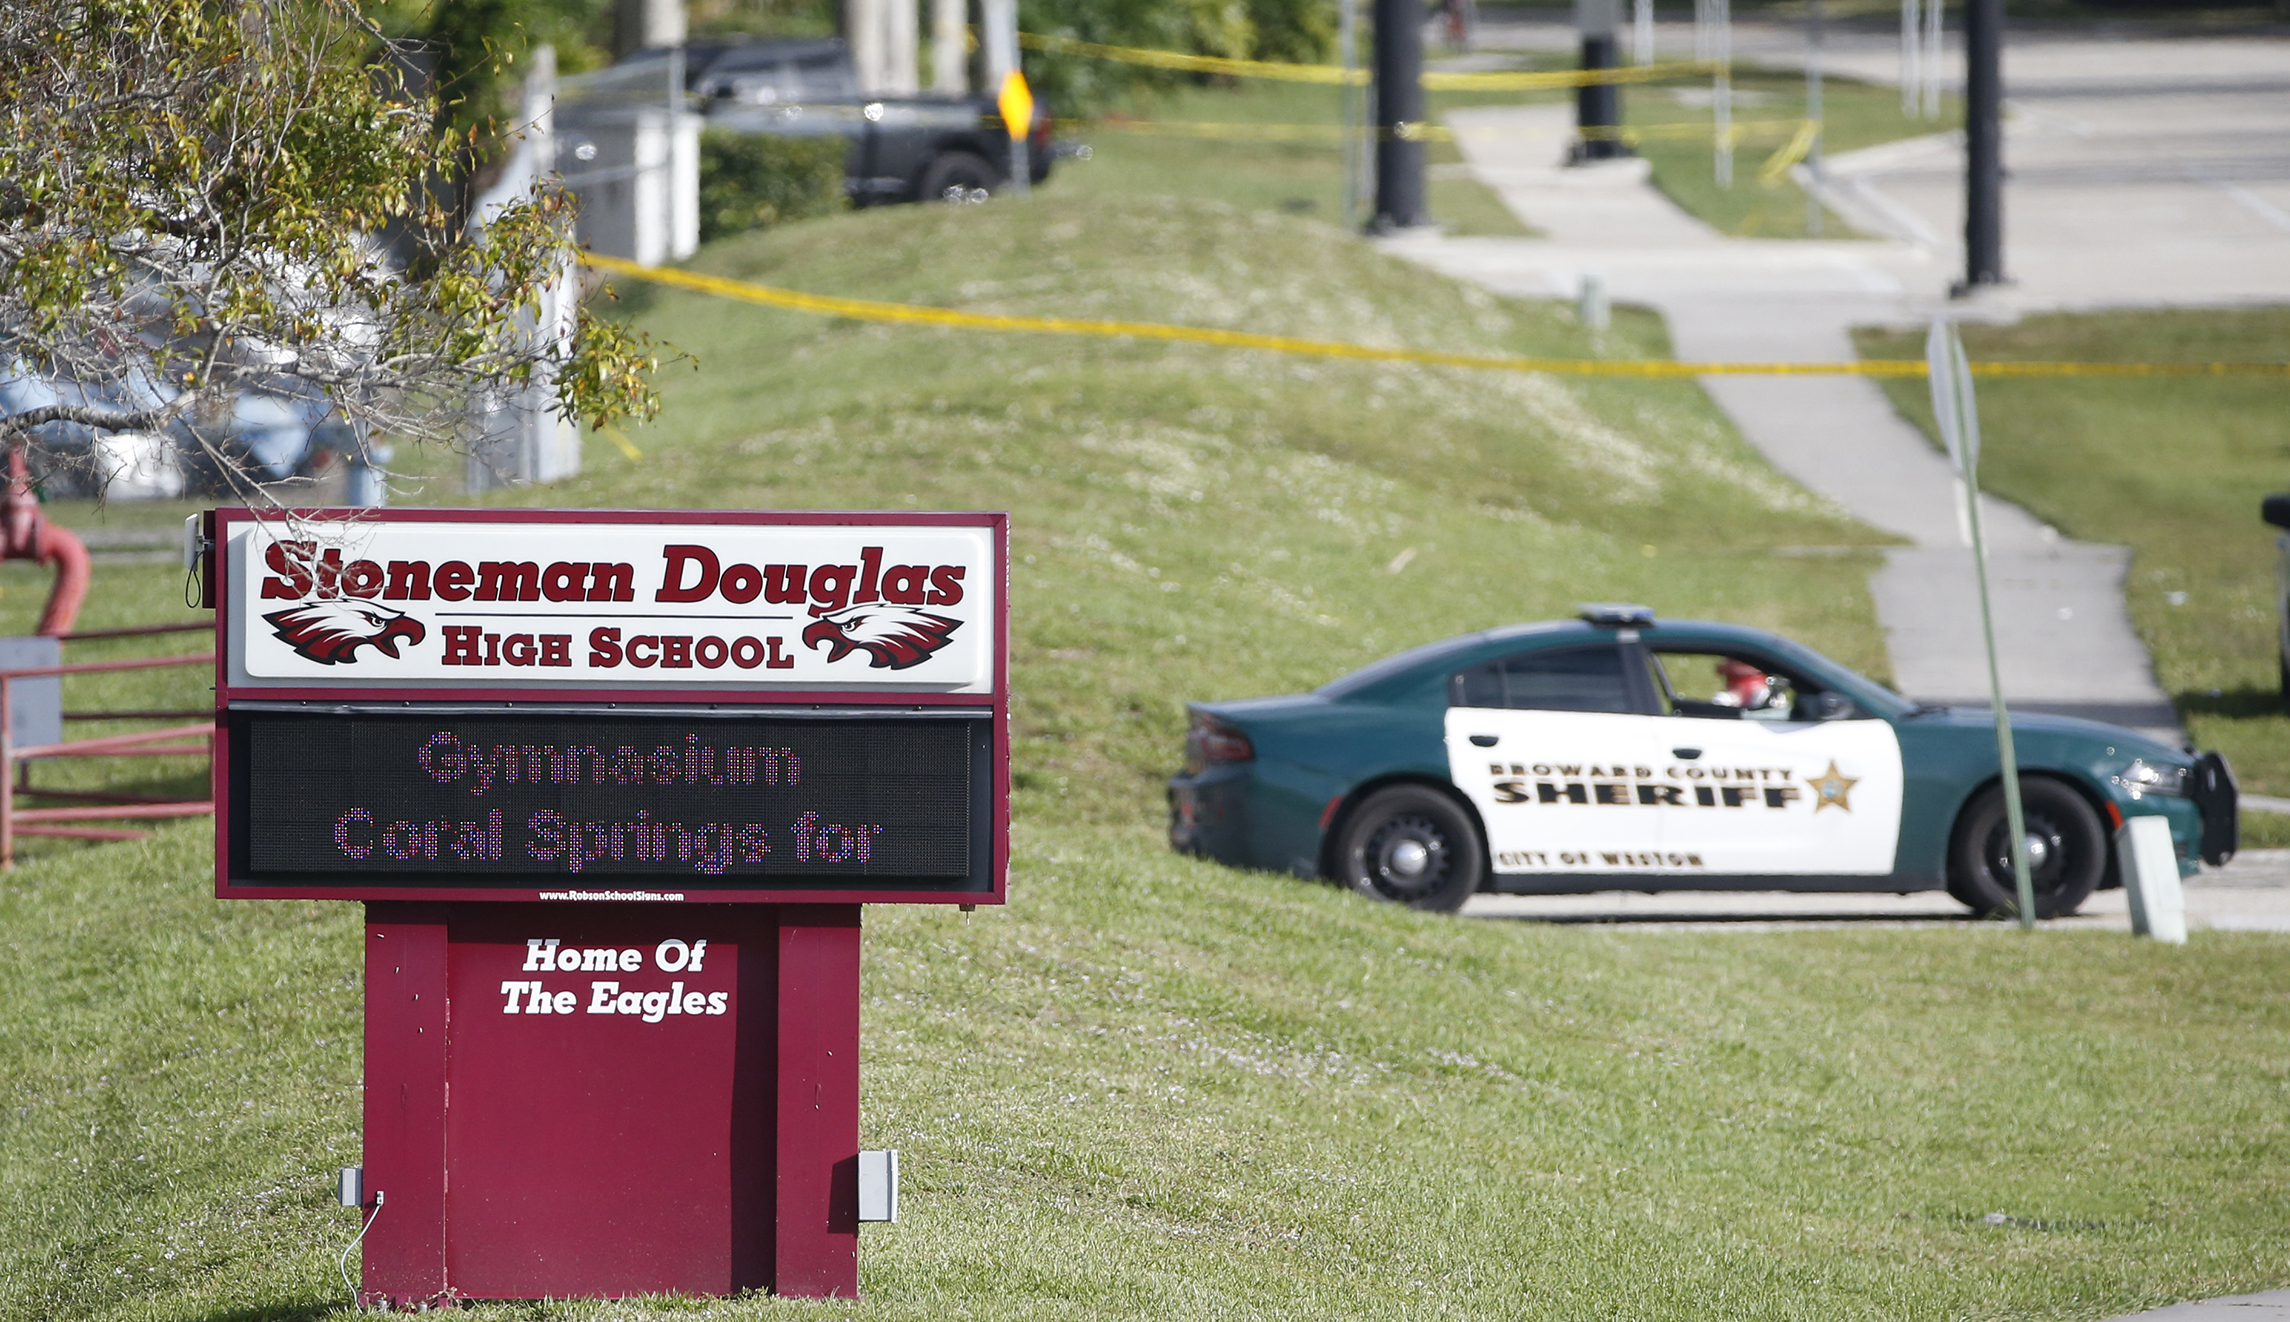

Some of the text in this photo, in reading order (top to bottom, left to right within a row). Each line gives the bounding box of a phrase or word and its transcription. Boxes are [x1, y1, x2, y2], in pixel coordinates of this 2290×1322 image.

[260, 539, 966, 618] Stoneman Douglas
[442, 625, 795, 669] HIGH SCHOOL
[418, 731, 801, 796] Gymnasium
[1489, 764, 1794, 781] BROWARD COUNTY
[1493, 782, 1802, 808] SHERIFF
[334, 807, 884, 875] Coral Springs for
[1499, 851, 1704, 868] CITY OF WESTON
[539, 890, 685, 902] www.RobsonSchoolSigns.com
[521, 939, 708, 973] Home Of
[500, 981, 729, 1024] The Eagles
